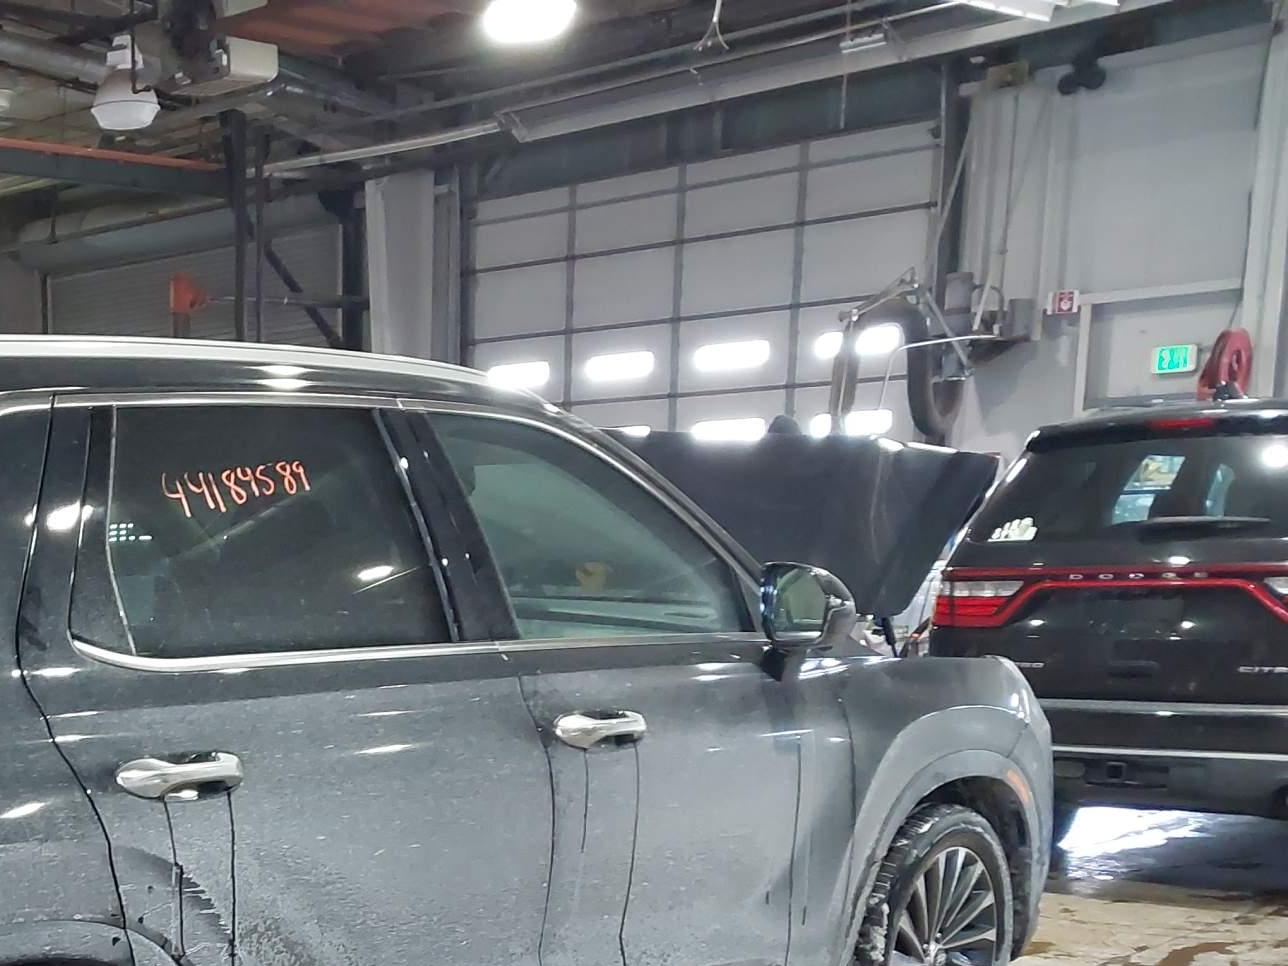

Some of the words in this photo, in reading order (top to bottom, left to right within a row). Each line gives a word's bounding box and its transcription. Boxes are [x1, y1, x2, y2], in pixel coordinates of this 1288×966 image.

[1158, 346, 1189, 371] EXIT
[161, 460, 312, 519] 44184589
[1068, 571, 1209, 581] DODGE
